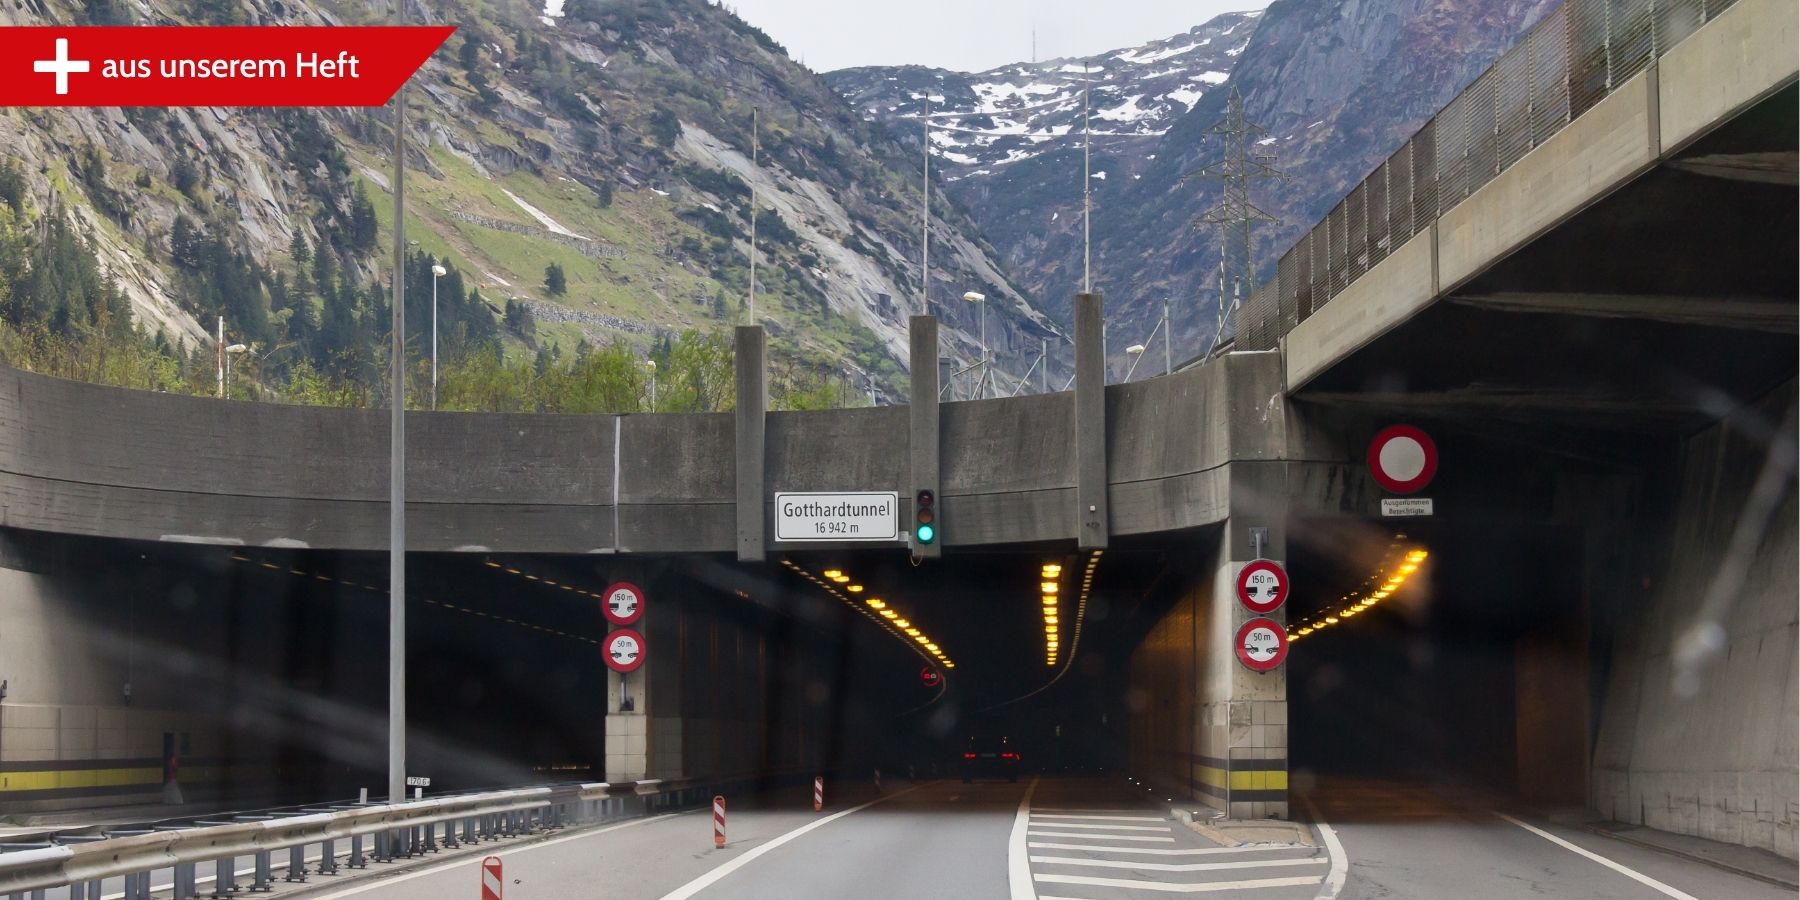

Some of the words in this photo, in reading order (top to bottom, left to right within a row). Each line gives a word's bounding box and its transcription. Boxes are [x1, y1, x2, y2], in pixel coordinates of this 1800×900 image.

[783, 500, 890, 518] Gotthardtunnel
[815, 522, 826, 534] 16
[828, 522, 847, 534] 942
[850, 524, 859, 533] m
[1252, 575, 1265, 584] 150
[1267, 576, 1274, 584] m
[614, 593, 626, 601] 150
[1253, 632, 1263, 642] 50
[617, 640, 626, 648] 50
